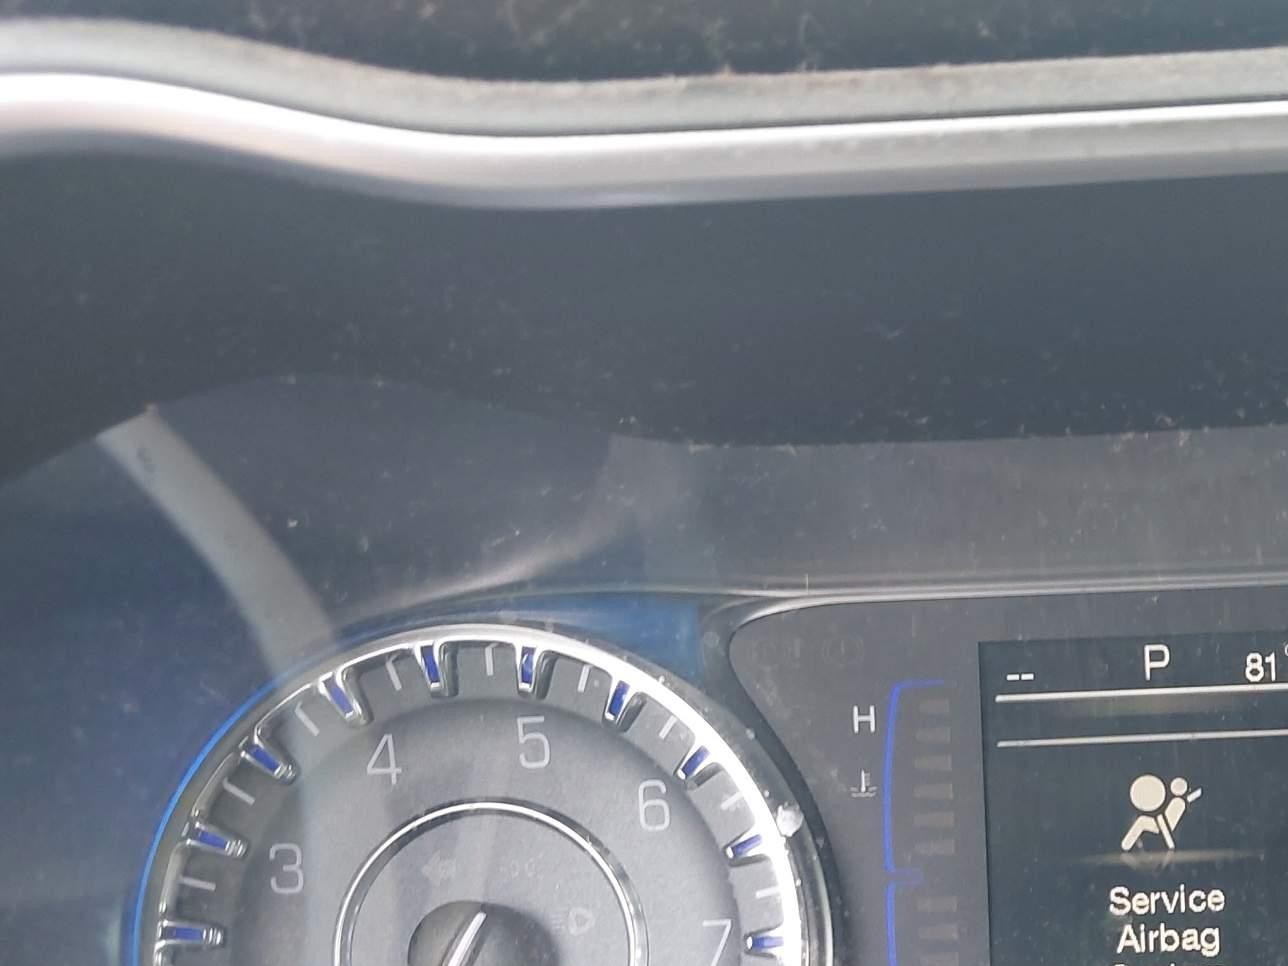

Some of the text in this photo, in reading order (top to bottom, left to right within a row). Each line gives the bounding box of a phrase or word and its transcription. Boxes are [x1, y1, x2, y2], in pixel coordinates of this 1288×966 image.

[1144, 644, 1170, 681] P
[852, 706, 877, 733] H
[367, 734, 401, 784] 4
[518, 716, 550, 768] 5
[638, 779, 670, 831] 6
[269, 843, 303, 894] 3
[1109, 885, 1226, 917] Service
[1117, 925, 1221, 957] Airbag
